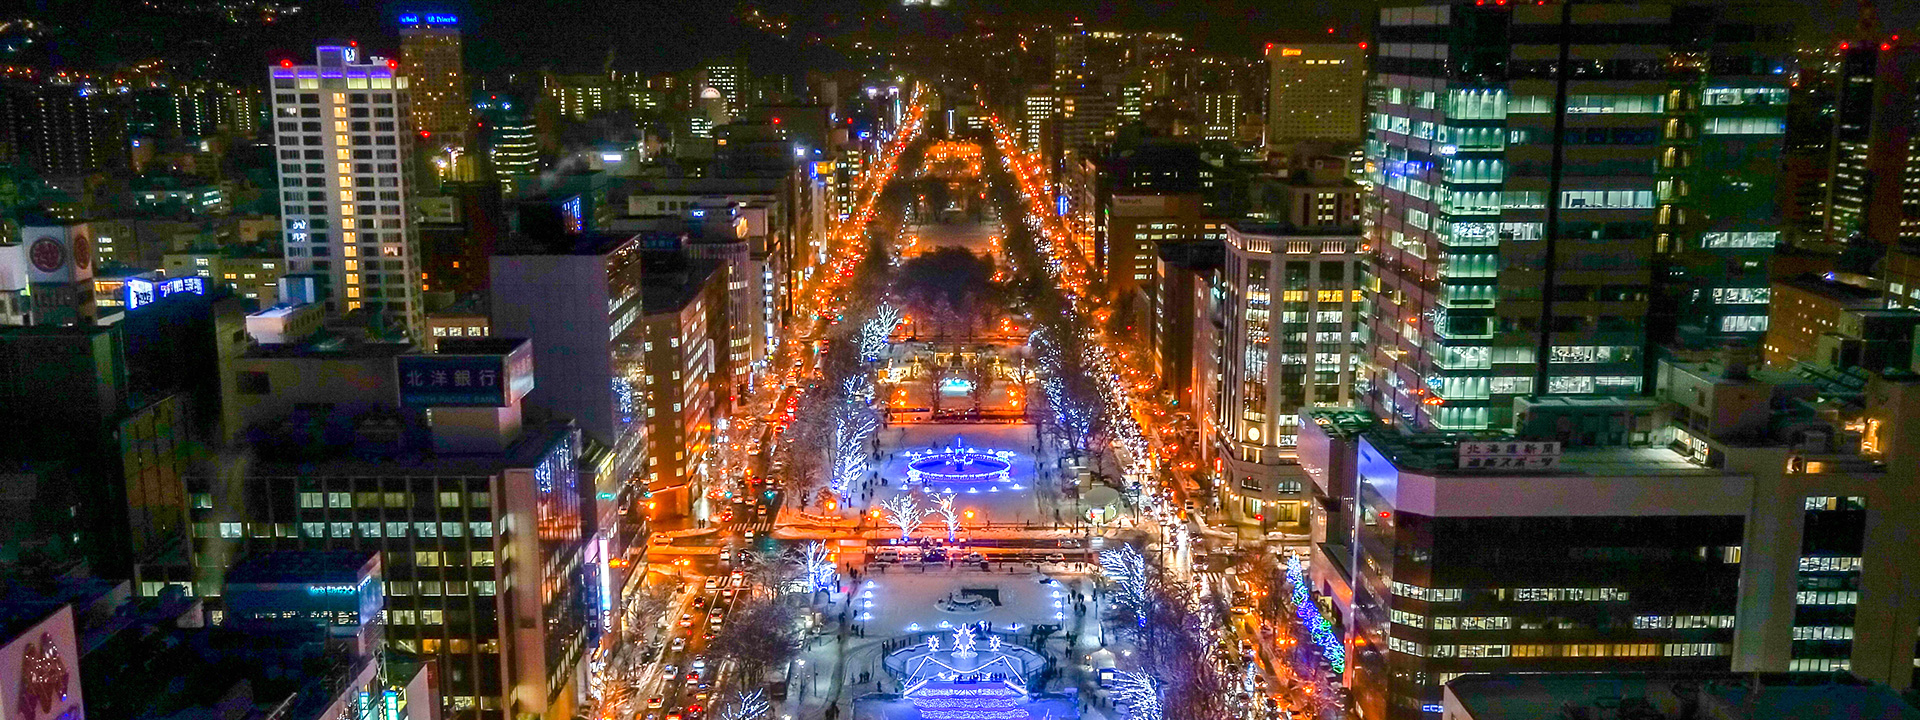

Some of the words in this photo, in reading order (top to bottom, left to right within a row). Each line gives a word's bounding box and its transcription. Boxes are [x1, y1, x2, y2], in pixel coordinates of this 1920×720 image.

[406, 369, 495, 387] 北洋銀行
[473, 395, 497, 404] BANK
[1467, 444, 1553, 454] 北海道新聞
